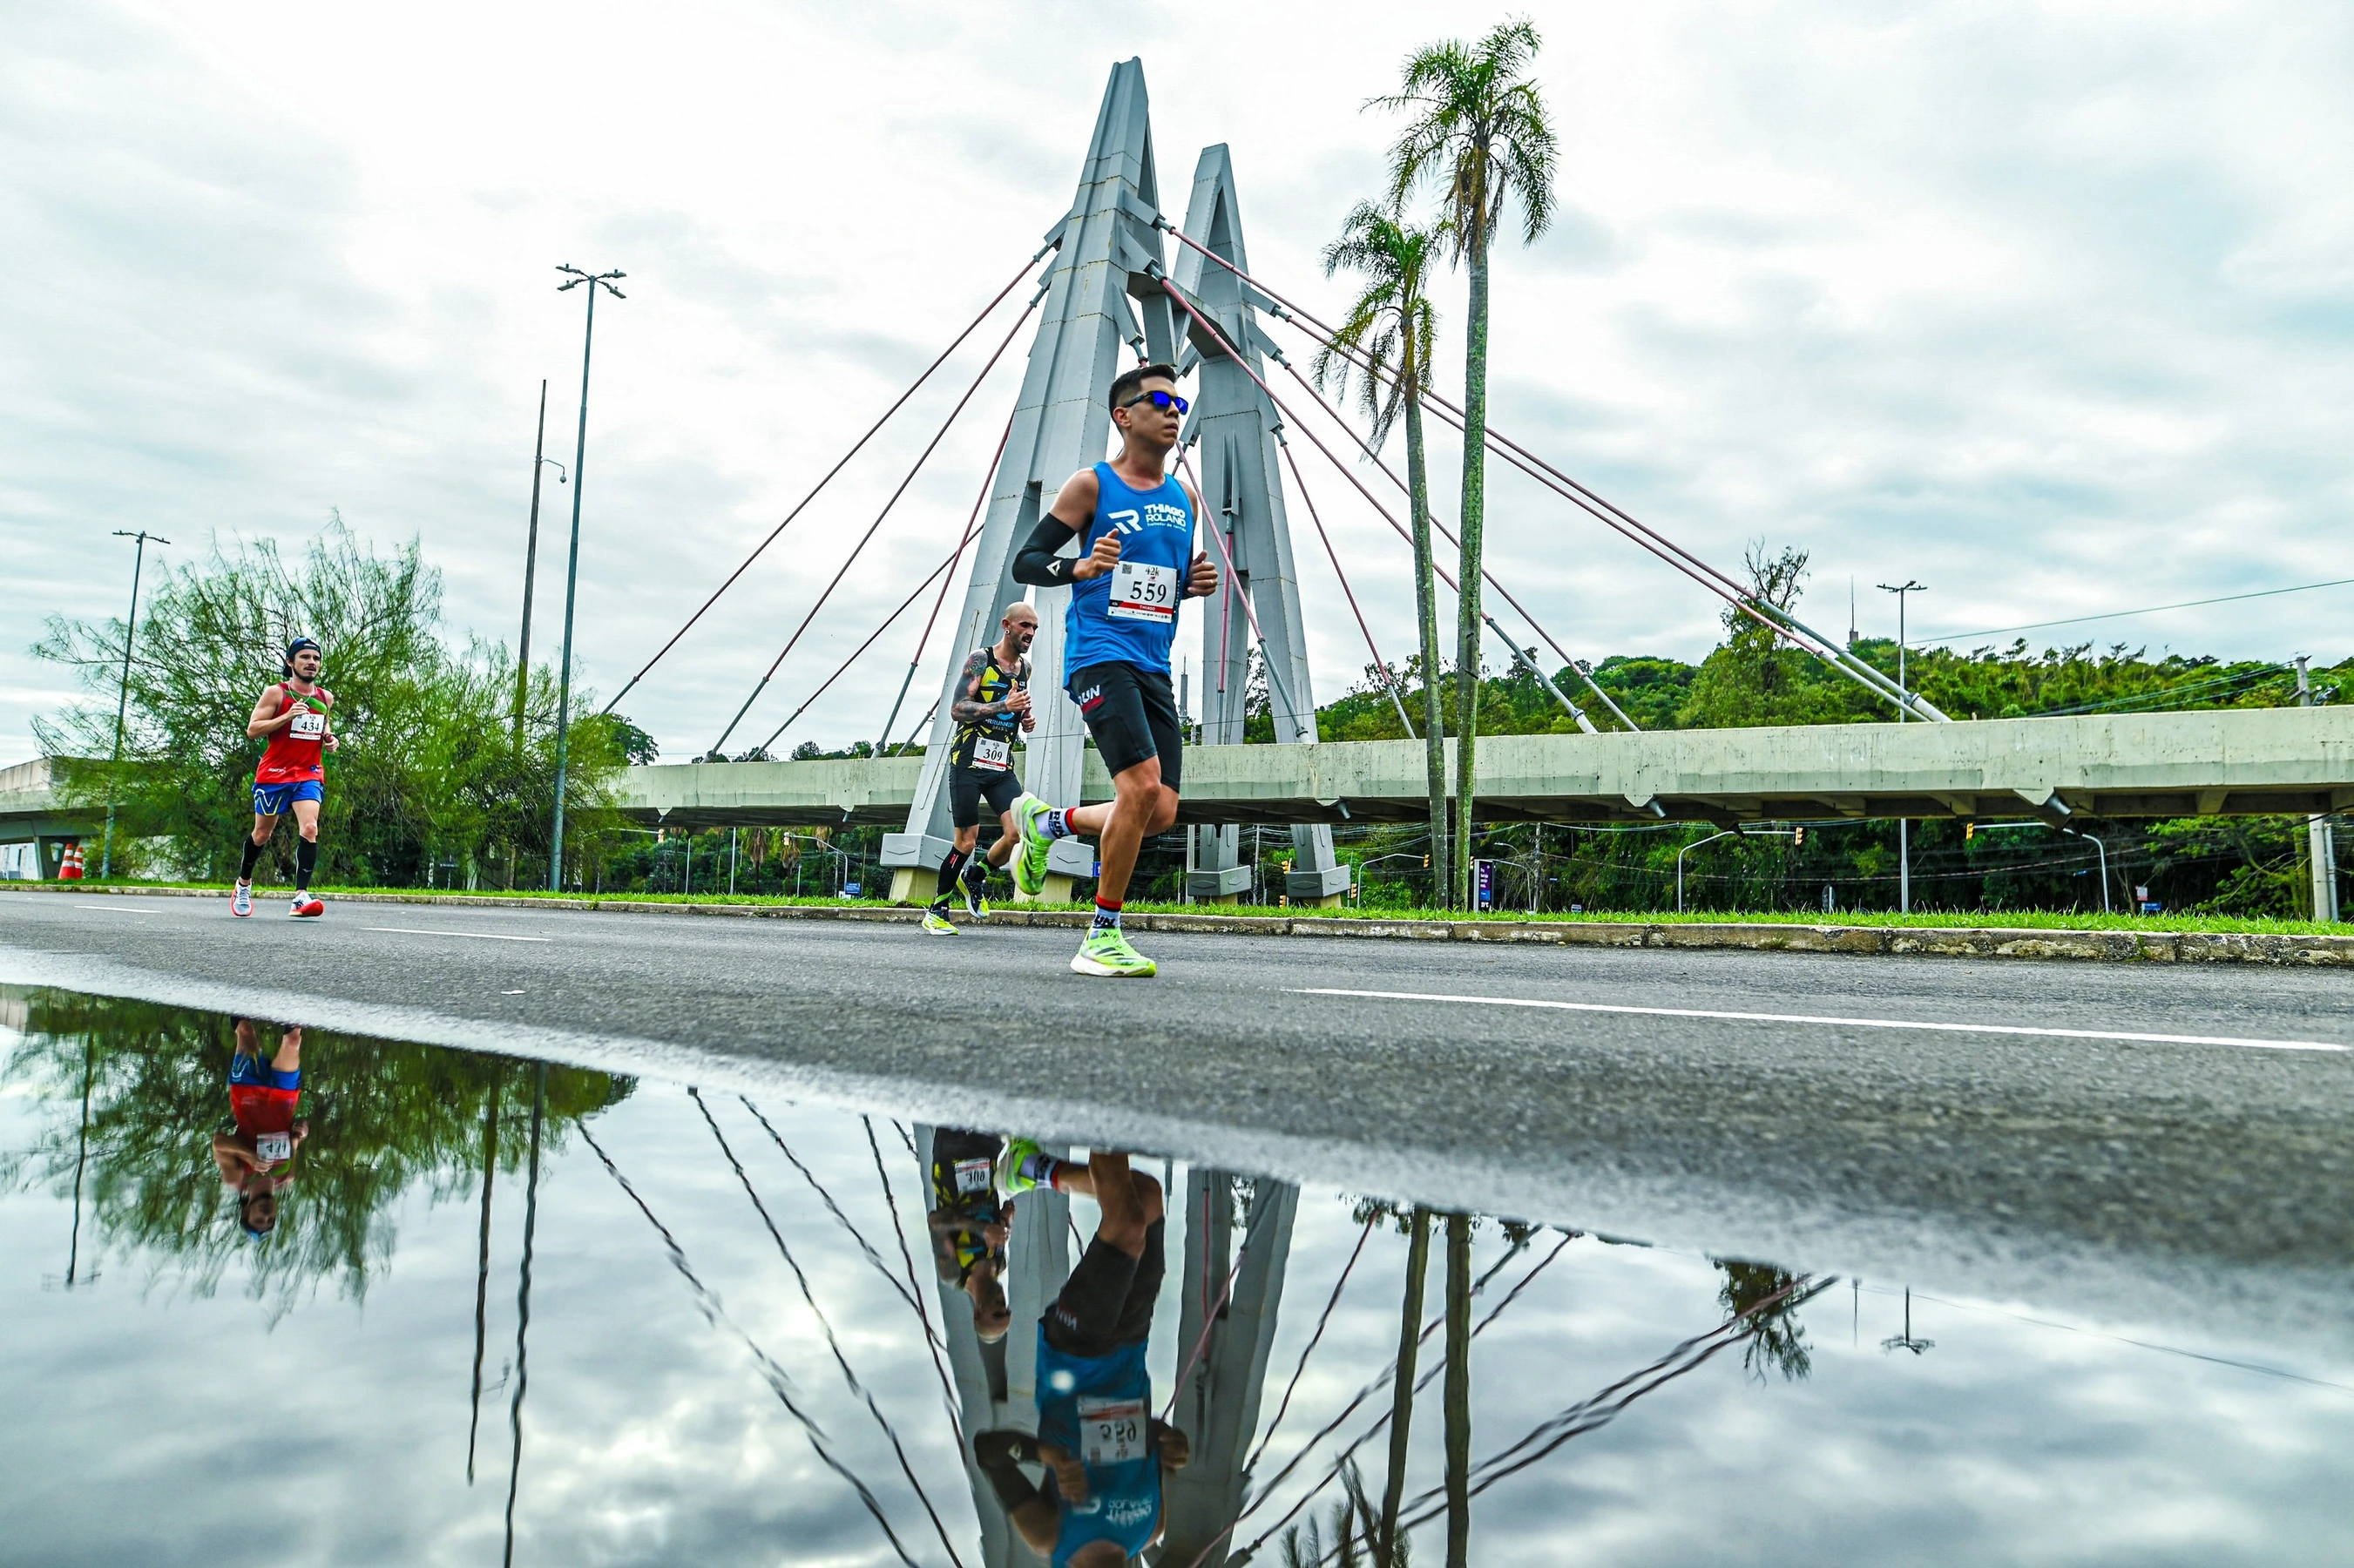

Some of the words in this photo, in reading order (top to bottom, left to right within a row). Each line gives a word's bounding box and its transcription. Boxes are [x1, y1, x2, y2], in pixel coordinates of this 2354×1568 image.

[1144, 504, 1186, 519] THIAGO
[1146, 513, 1187, 527] ROLAND
[1130, 580, 1167, 603] 559
[301, 721, 319, 731] 434
[983, 748, 1003, 761] 309
